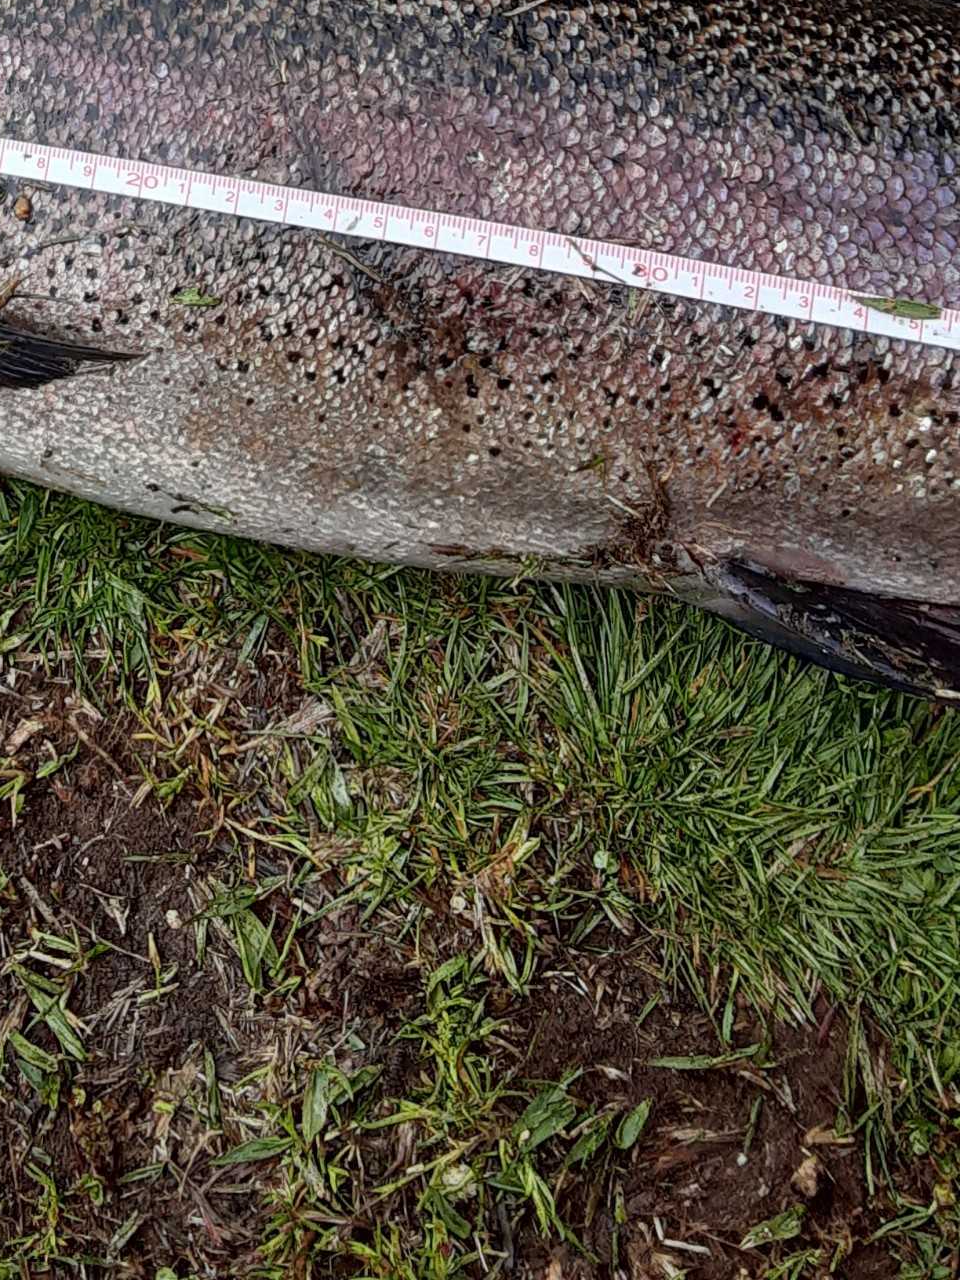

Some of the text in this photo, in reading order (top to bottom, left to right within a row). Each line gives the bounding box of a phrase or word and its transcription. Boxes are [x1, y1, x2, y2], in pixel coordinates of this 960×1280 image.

[37, 157, 45, 168] 8
[83, 165, 91, 176] 9
[126, 172, 159, 189] 20
[226, 192, 234, 202] 2
[274, 200, 283, 211] 3
[324, 208, 333, 218] 4
[374, 217, 383, 228] 5
[424, 226, 434, 238] 6
[478, 235, 486, 246] 7
[529, 245, 538, 256] 8
[744, 286, 754, 298] 2
[799, 295, 809, 307] 3
[853, 307, 864, 318] 4
